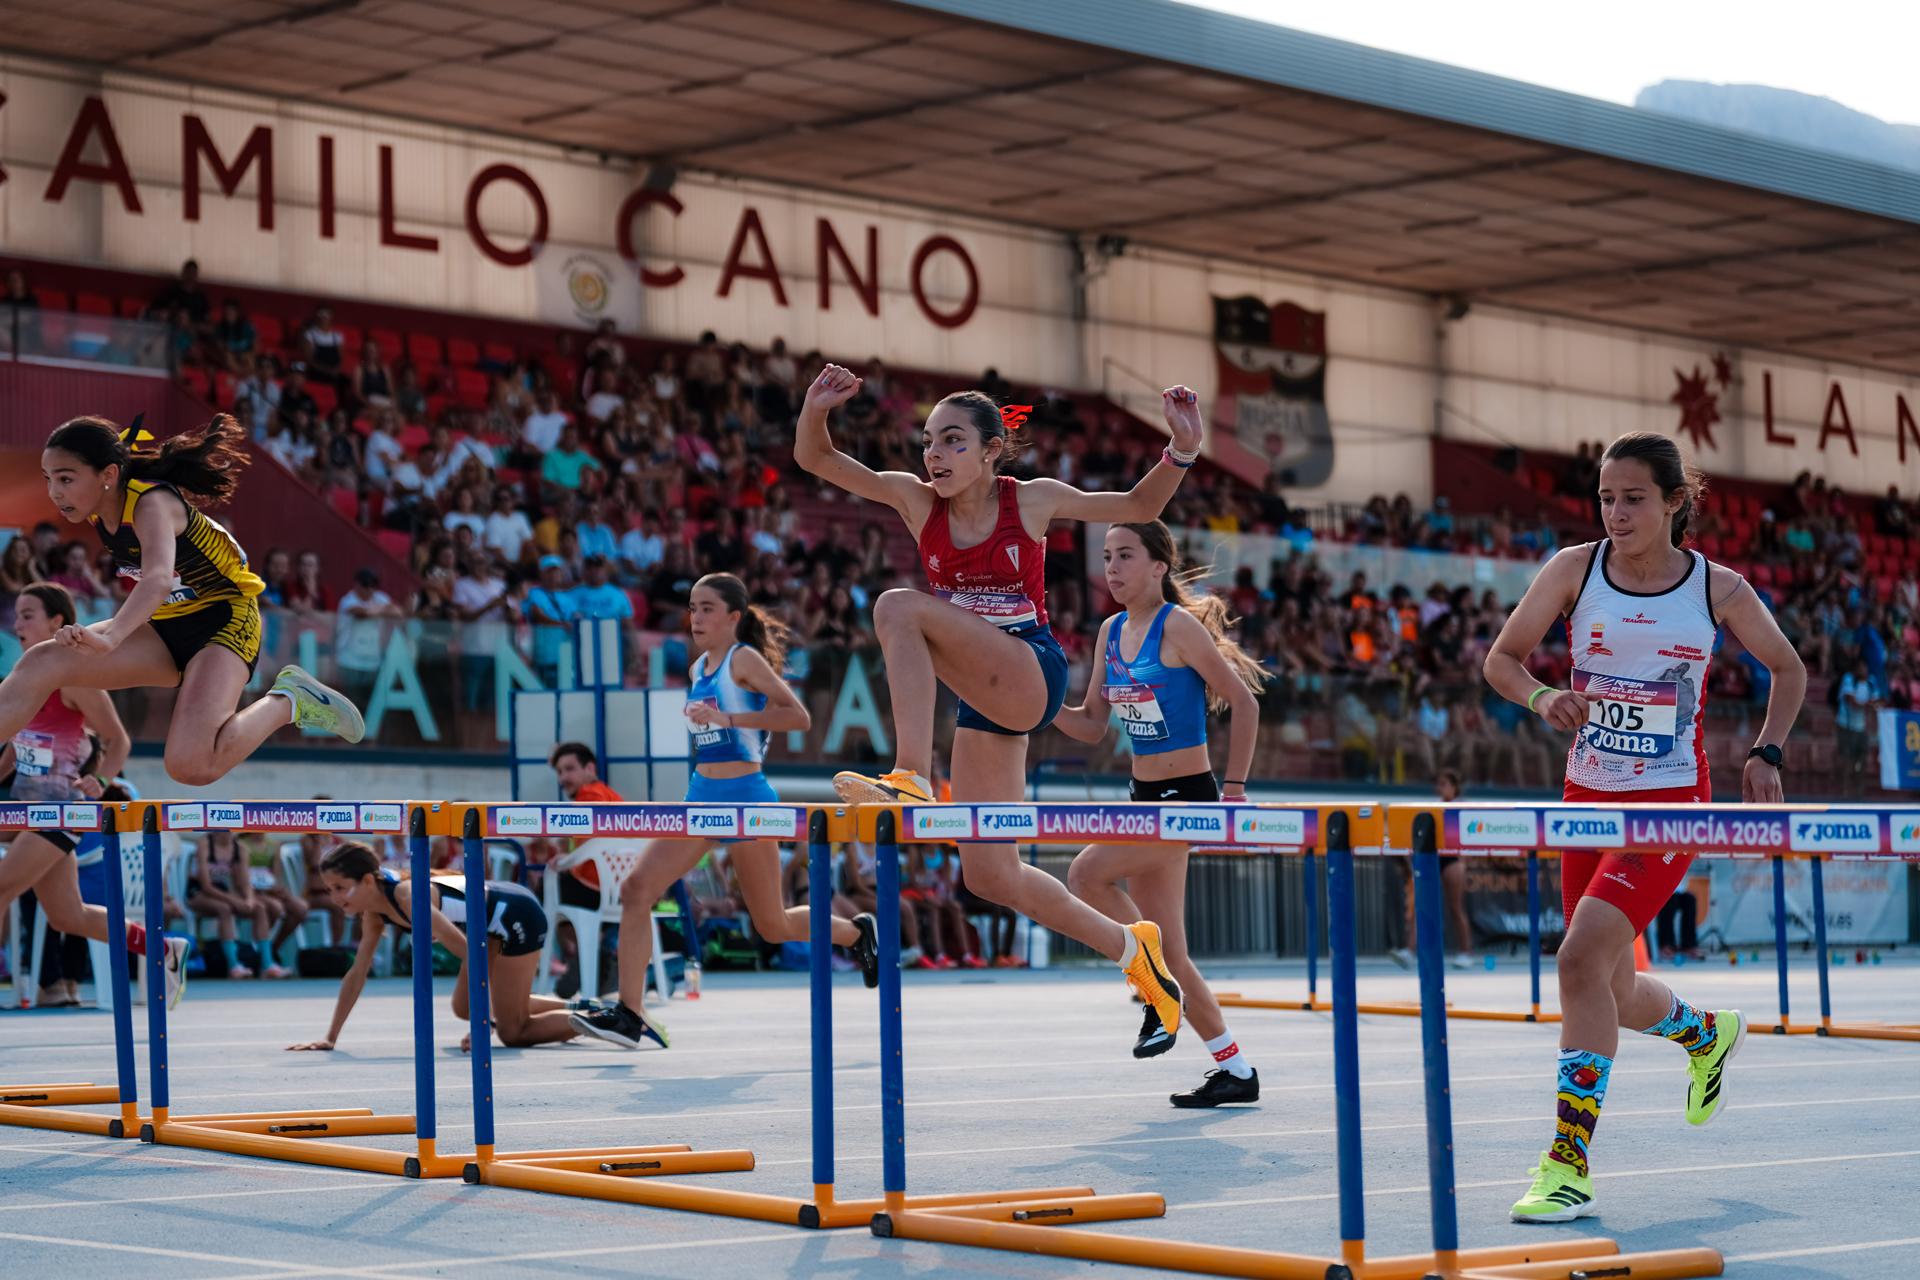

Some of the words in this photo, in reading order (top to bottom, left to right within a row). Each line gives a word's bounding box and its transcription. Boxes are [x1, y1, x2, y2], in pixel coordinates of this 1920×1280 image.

[0, 86, 549, 267] AMILO
[616, 186, 980, 328] CANO
[1763, 370, 1859, 457] LA
[957, 580, 1024, 593] MARATHON
[1597, 700, 1644, 731] 105
[1646, 761, 1689, 771] PUERTOLLANO
[6, 810, 26, 825] 2026
[246, 811, 261, 825] LA
[261, 807, 290, 826] NUCÍA
[291, 811, 314, 826] 2026
[597, 814, 612, 831] LA
[614, 809, 651, 831] NUCÍA
[654, 814, 684, 832] 2026
[1043, 813, 1062, 833] LA
[1065, 808, 1114, 834] NUCÍA
[1117, 815, 1155, 835] 2026
[1632, 819, 1659, 843] LA
[1662, 814, 1728, 845] NUCÍA
[1732, 821, 1783, 846] 2026
